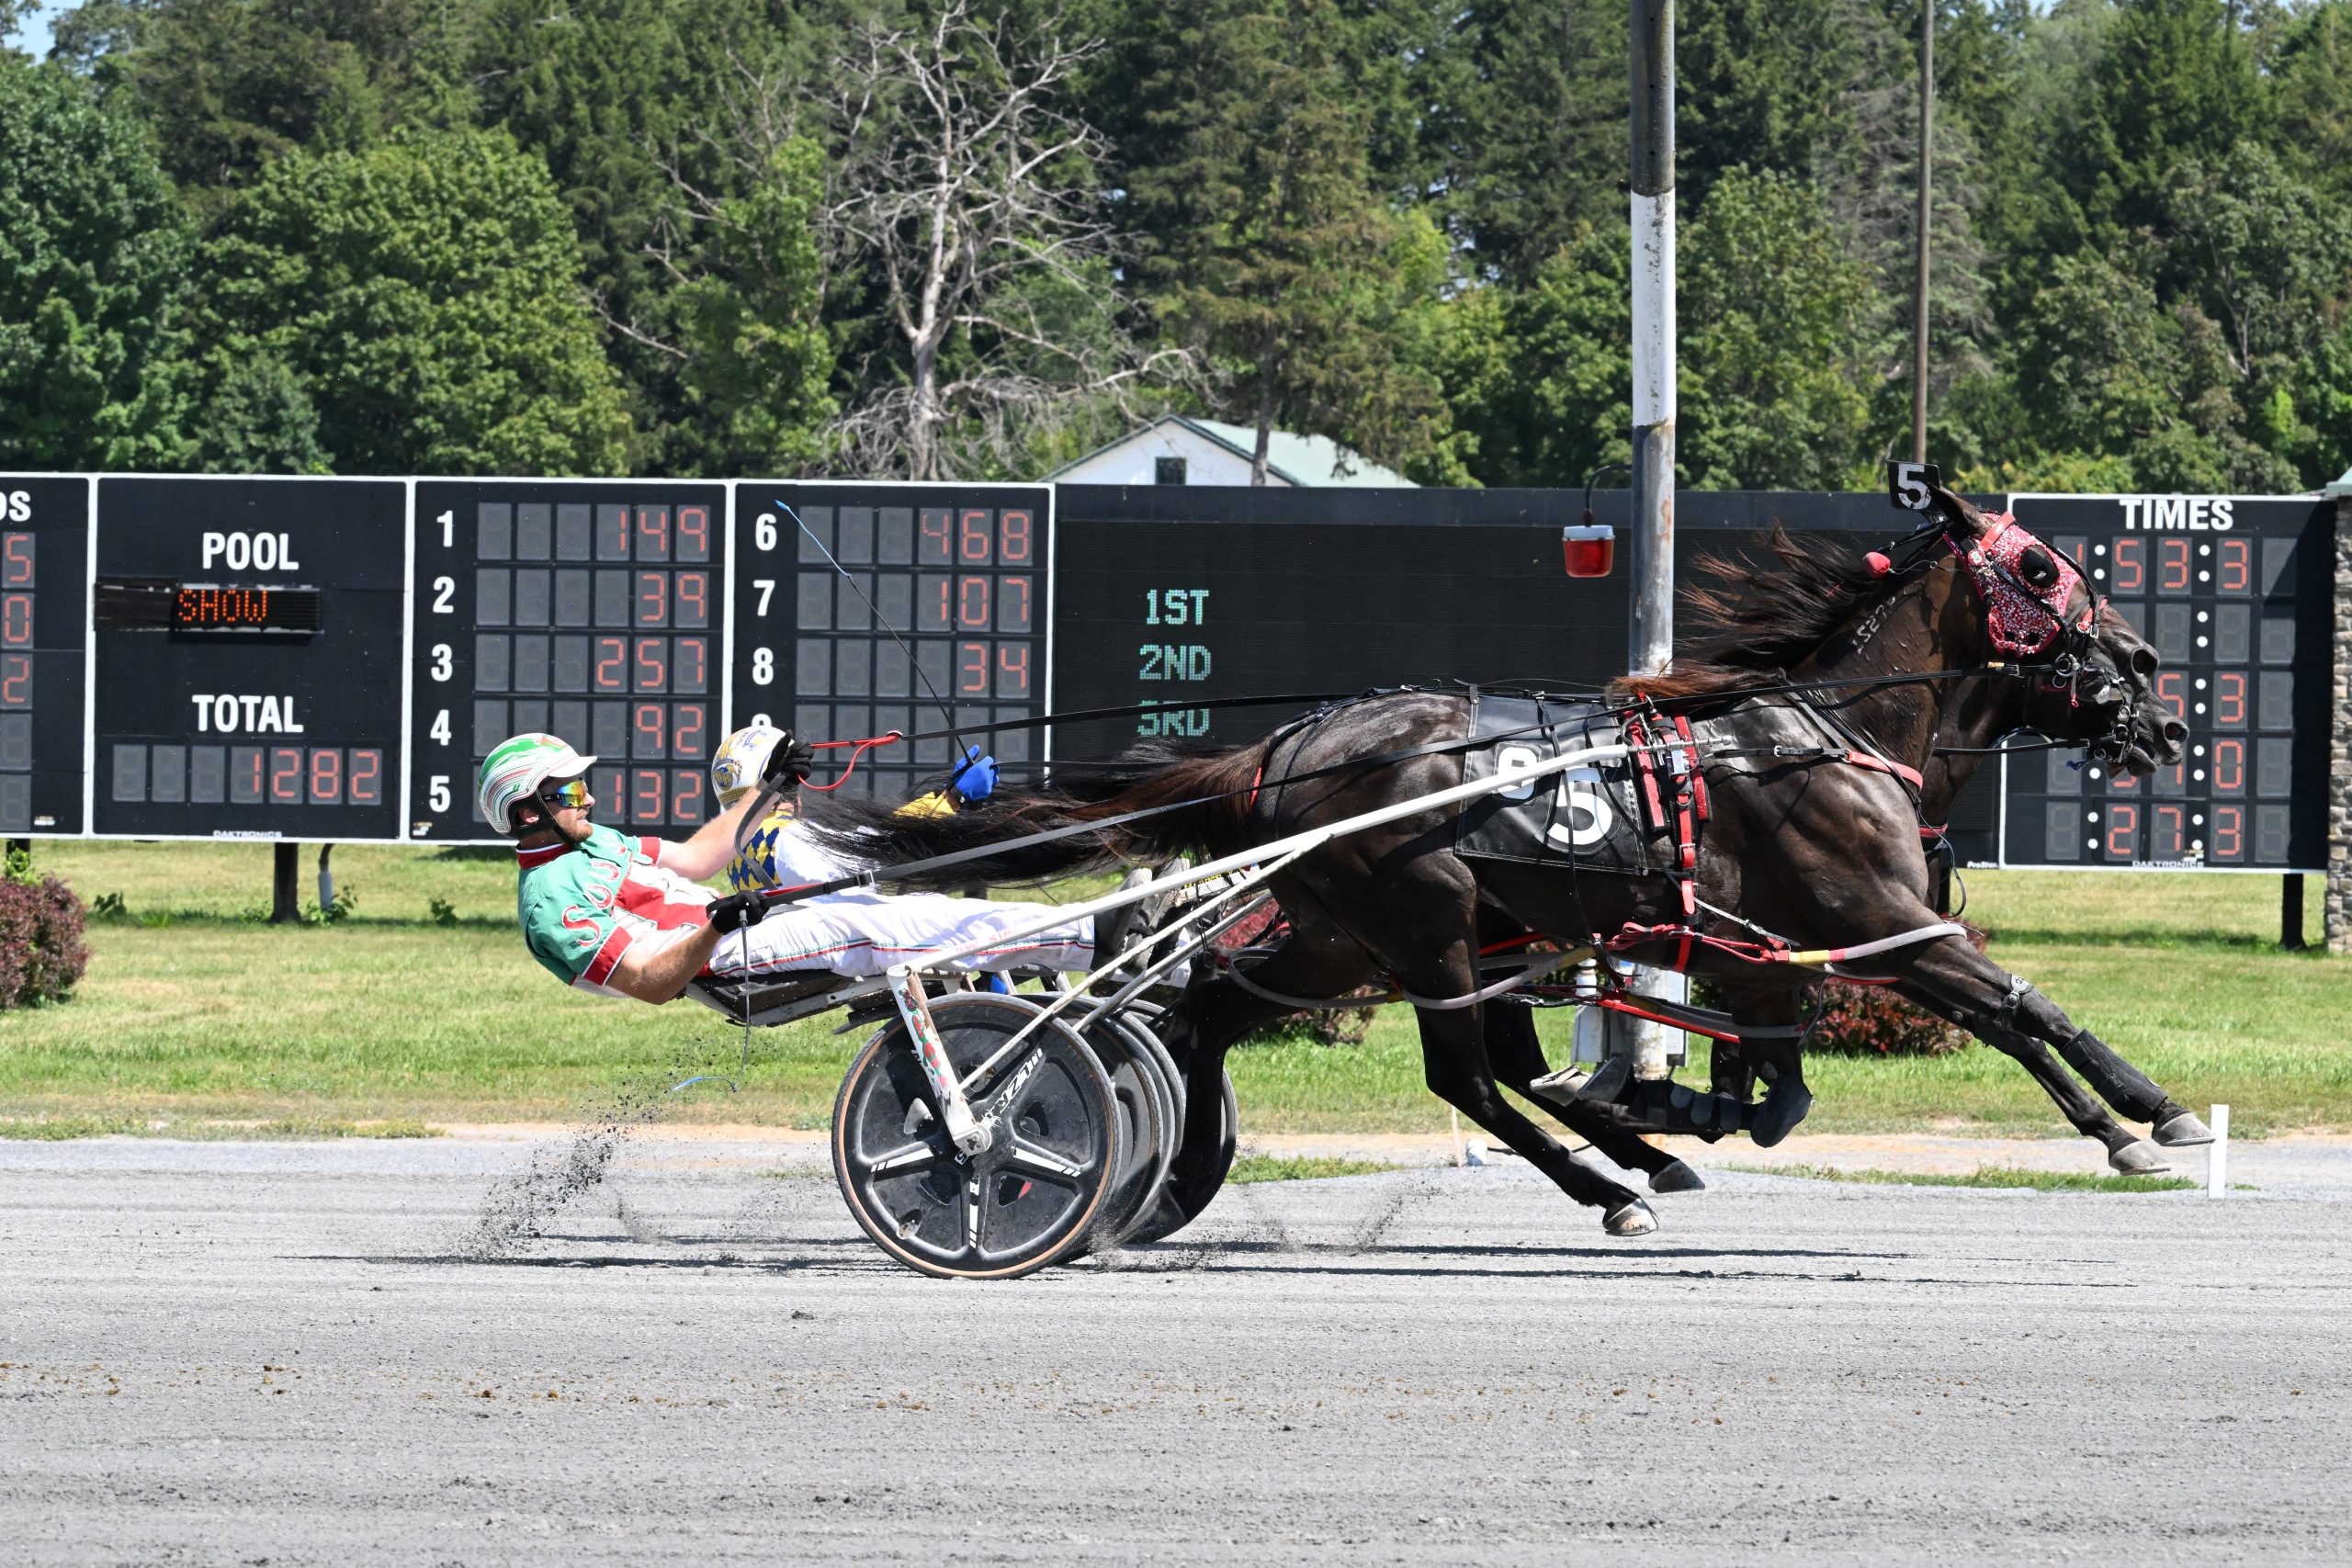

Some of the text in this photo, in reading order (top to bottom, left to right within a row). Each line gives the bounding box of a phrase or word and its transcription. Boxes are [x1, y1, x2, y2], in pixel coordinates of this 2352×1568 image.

[1897, 463, 1931, 510] 5
[436, 507, 707, 553] 1 149
[755, 511, 1030, 560] 6 468
[2119, 499, 2233, 531] TIMES
[6, 536, 31, 581] 5
[202, 532, 300, 570] POOL
[5, 595, 30, 642] 0
[178, 589, 267, 622] SHOW
[433, 574, 706, 621] 2 39
[753, 578, 1029, 626] 7 107
[1146, 589, 1210, 626] 1ST
[4, 658, 28, 703] 2
[431, 638, 704, 687] 3 257
[752, 644, 1027, 692] 8 34
[1139, 644, 1212, 681] 2ND
[191, 694, 304, 733] TOTAL
[430, 709, 452, 746] 4
[636, 705, 704, 753] 92
[254, 750, 379, 798] 1282
[429, 775, 451, 813] 5
[615, 771, 701, 819] 132
[1547, 767, 1612, 845] 5
